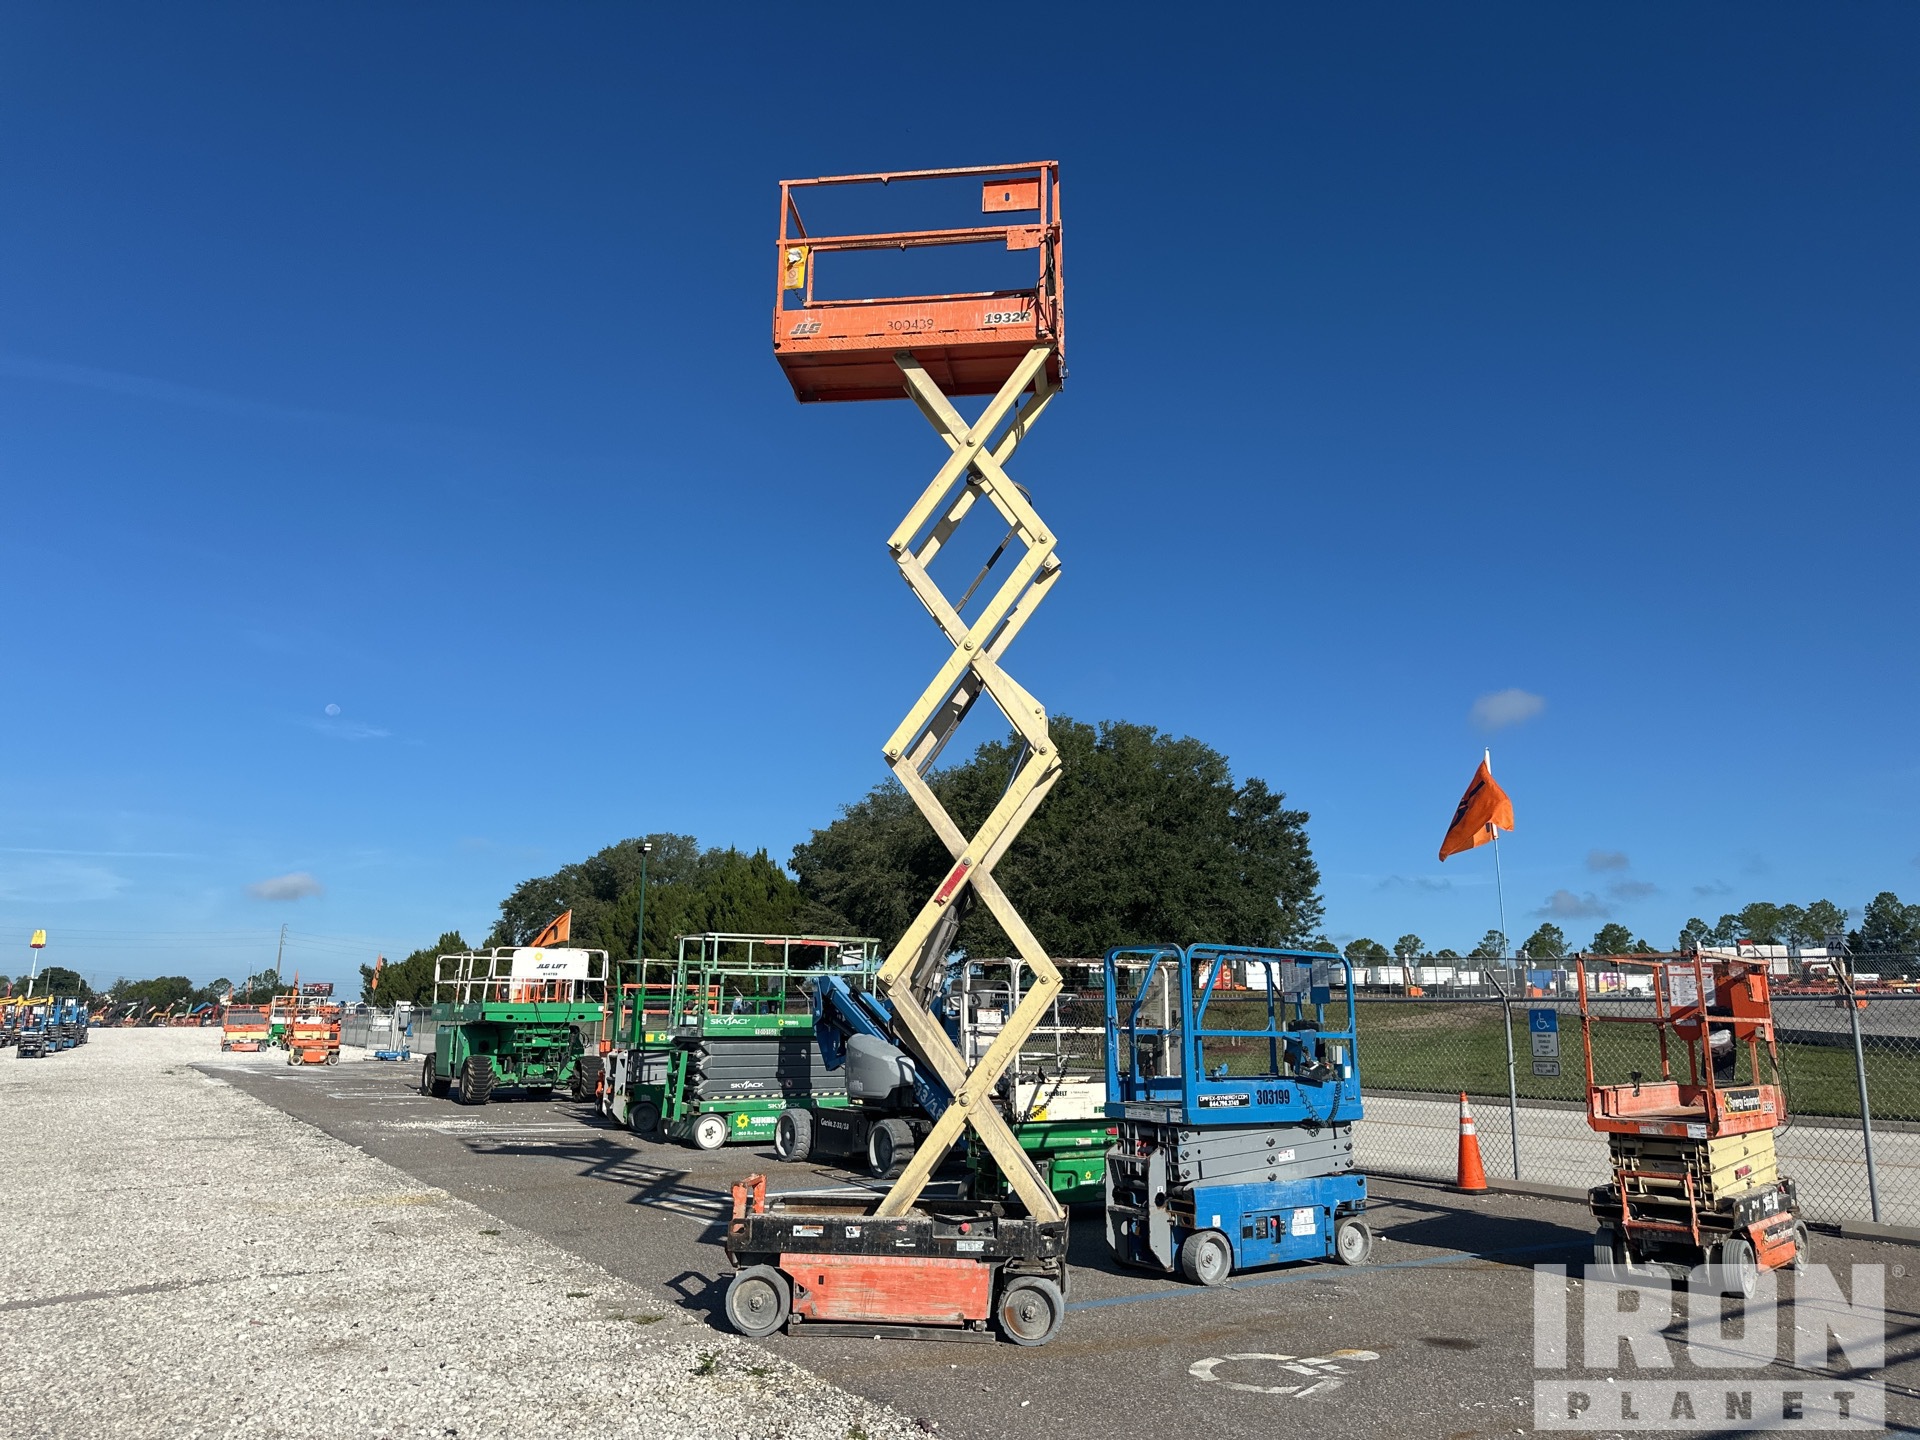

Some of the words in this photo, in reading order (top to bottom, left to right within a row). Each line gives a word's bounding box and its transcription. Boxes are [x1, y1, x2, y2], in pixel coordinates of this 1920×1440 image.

[790, 322, 822, 335] JLG
[887, 318, 934, 331] 300439
[1827, 941, 1842, 951] 44
[730, 1080, 764, 1090] SKYJACK
[1256, 1089, 1290, 1105] 303199
[767, 1101, 800, 1109] SKYJACK
